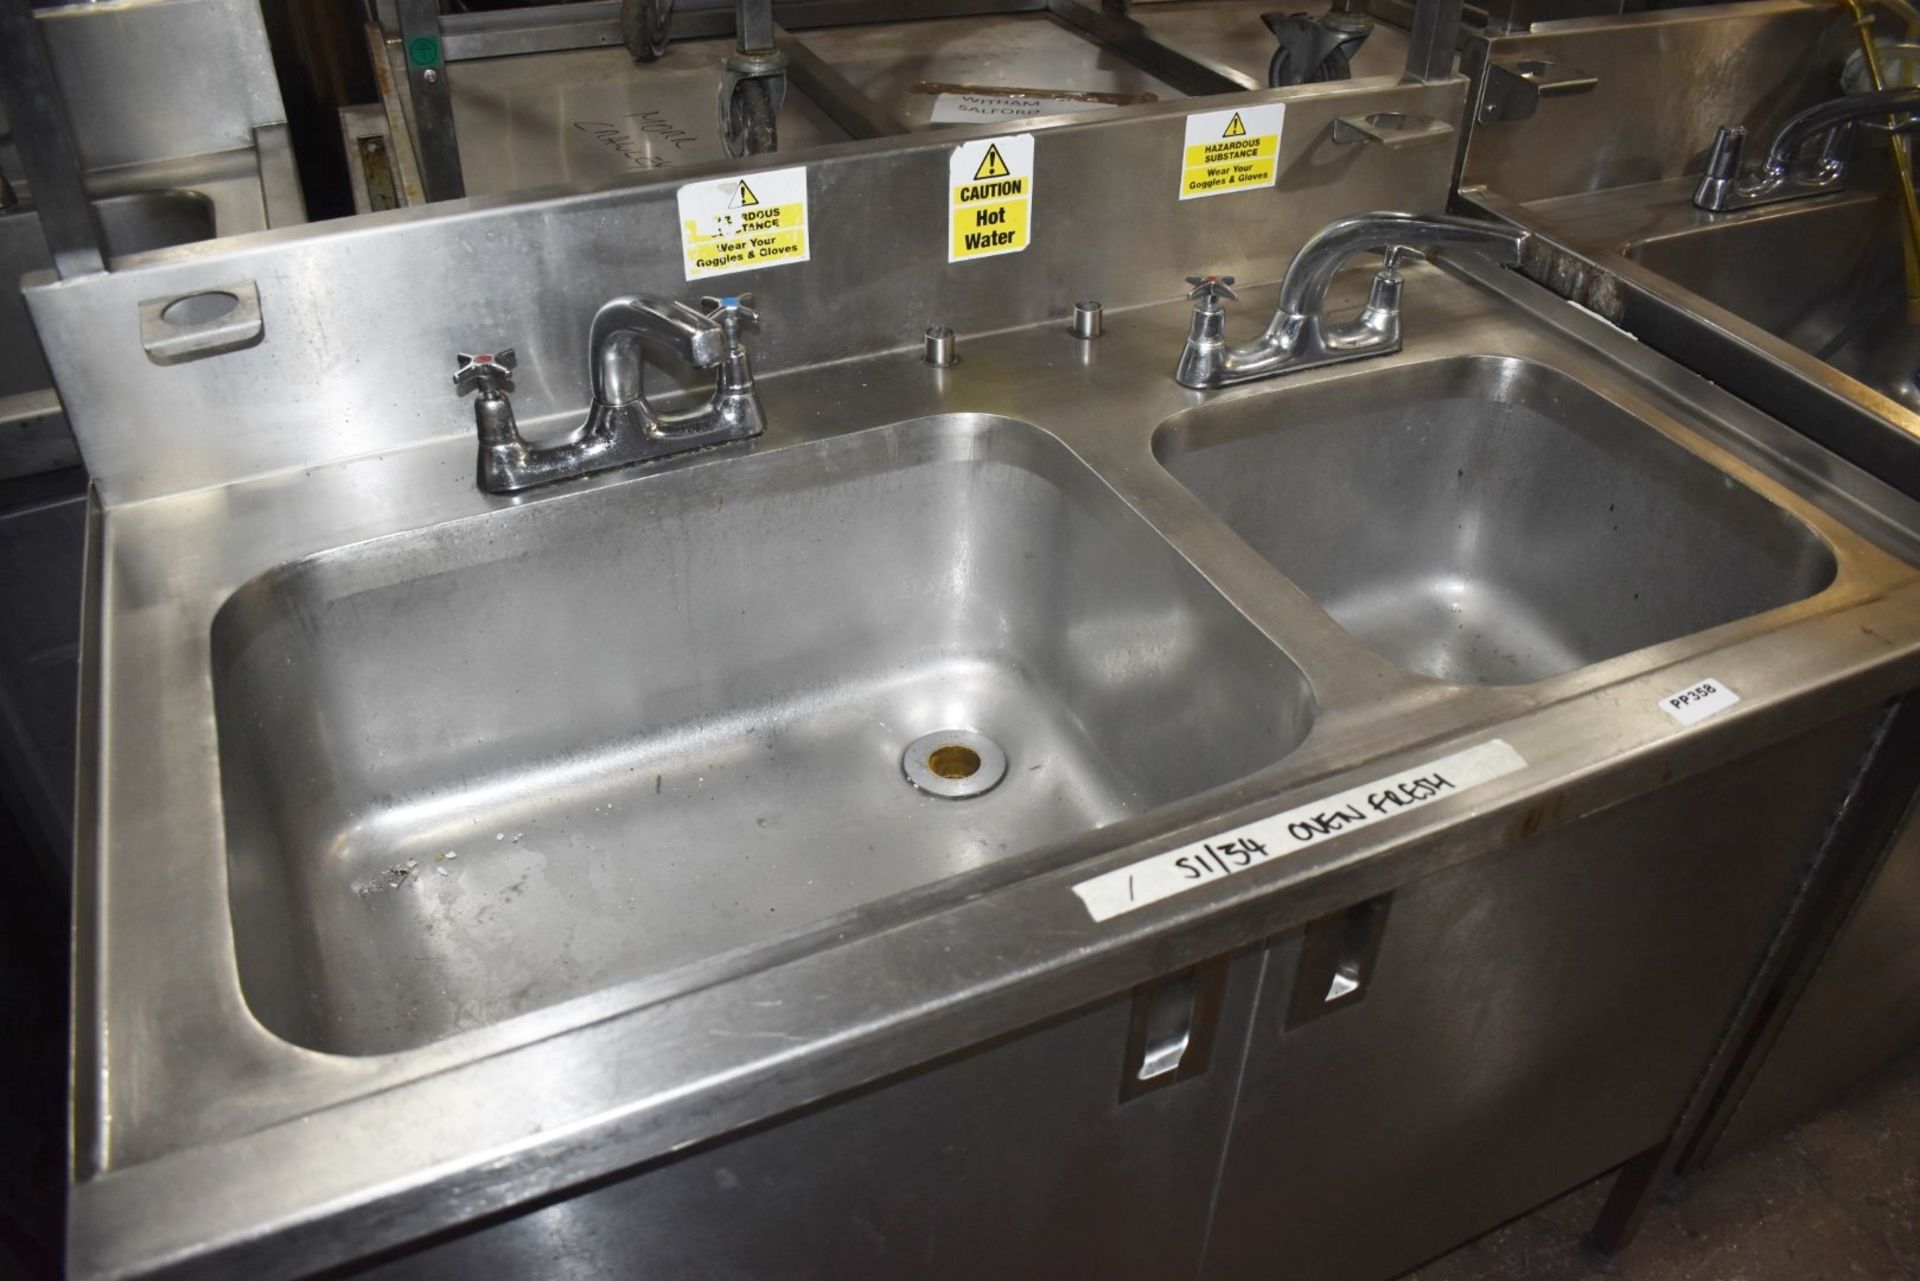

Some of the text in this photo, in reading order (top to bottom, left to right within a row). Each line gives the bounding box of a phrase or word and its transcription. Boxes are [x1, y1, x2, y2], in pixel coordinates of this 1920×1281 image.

[958, 105, 1040, 115] SALFORD
[961, 95, 1040, 107] WITHAM
[1205, 138, 1260, 154] HAZARDOUS
[1205, 148, 1258, 163] SUBSTANCE
[1207, 164, 1253, 177] Wear Your
[1189, 171, 1268, 190] Goggles & Gloves
[960, 180, 1022, 202] CAUTION
[976, 207, 1006, 227] Hot
[717, 236, 776, 253] Wear Your
[965, 230, 1015, 250] Water
[696, 244, 798, 269] Goggles & Gloves
[1669, 683, 1717, 710] PP358
[1288, 804, 1367, 842] OVEN
[1367, 773, 1456, 814] FRESH
